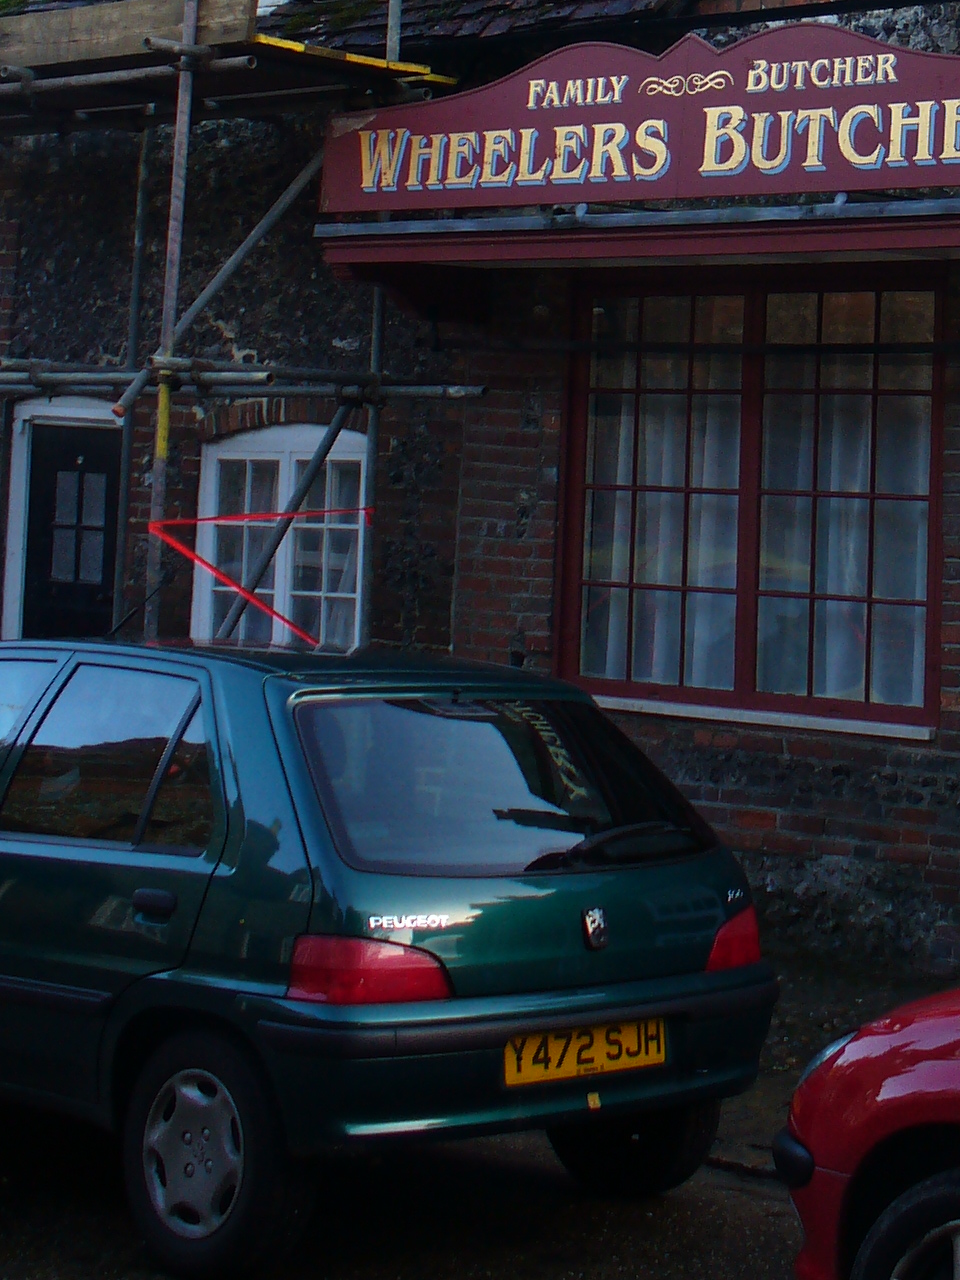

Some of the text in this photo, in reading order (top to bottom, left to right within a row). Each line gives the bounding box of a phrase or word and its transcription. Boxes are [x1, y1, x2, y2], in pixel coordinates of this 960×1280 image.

[527, 53, 899, 109] FAMILY BUTCHER
[358, 119, 671, 193] WHEELERS
[369, 915, 449, 929] PEUGEOT
[508, 1019, 661, 1073] Y472 SJH
